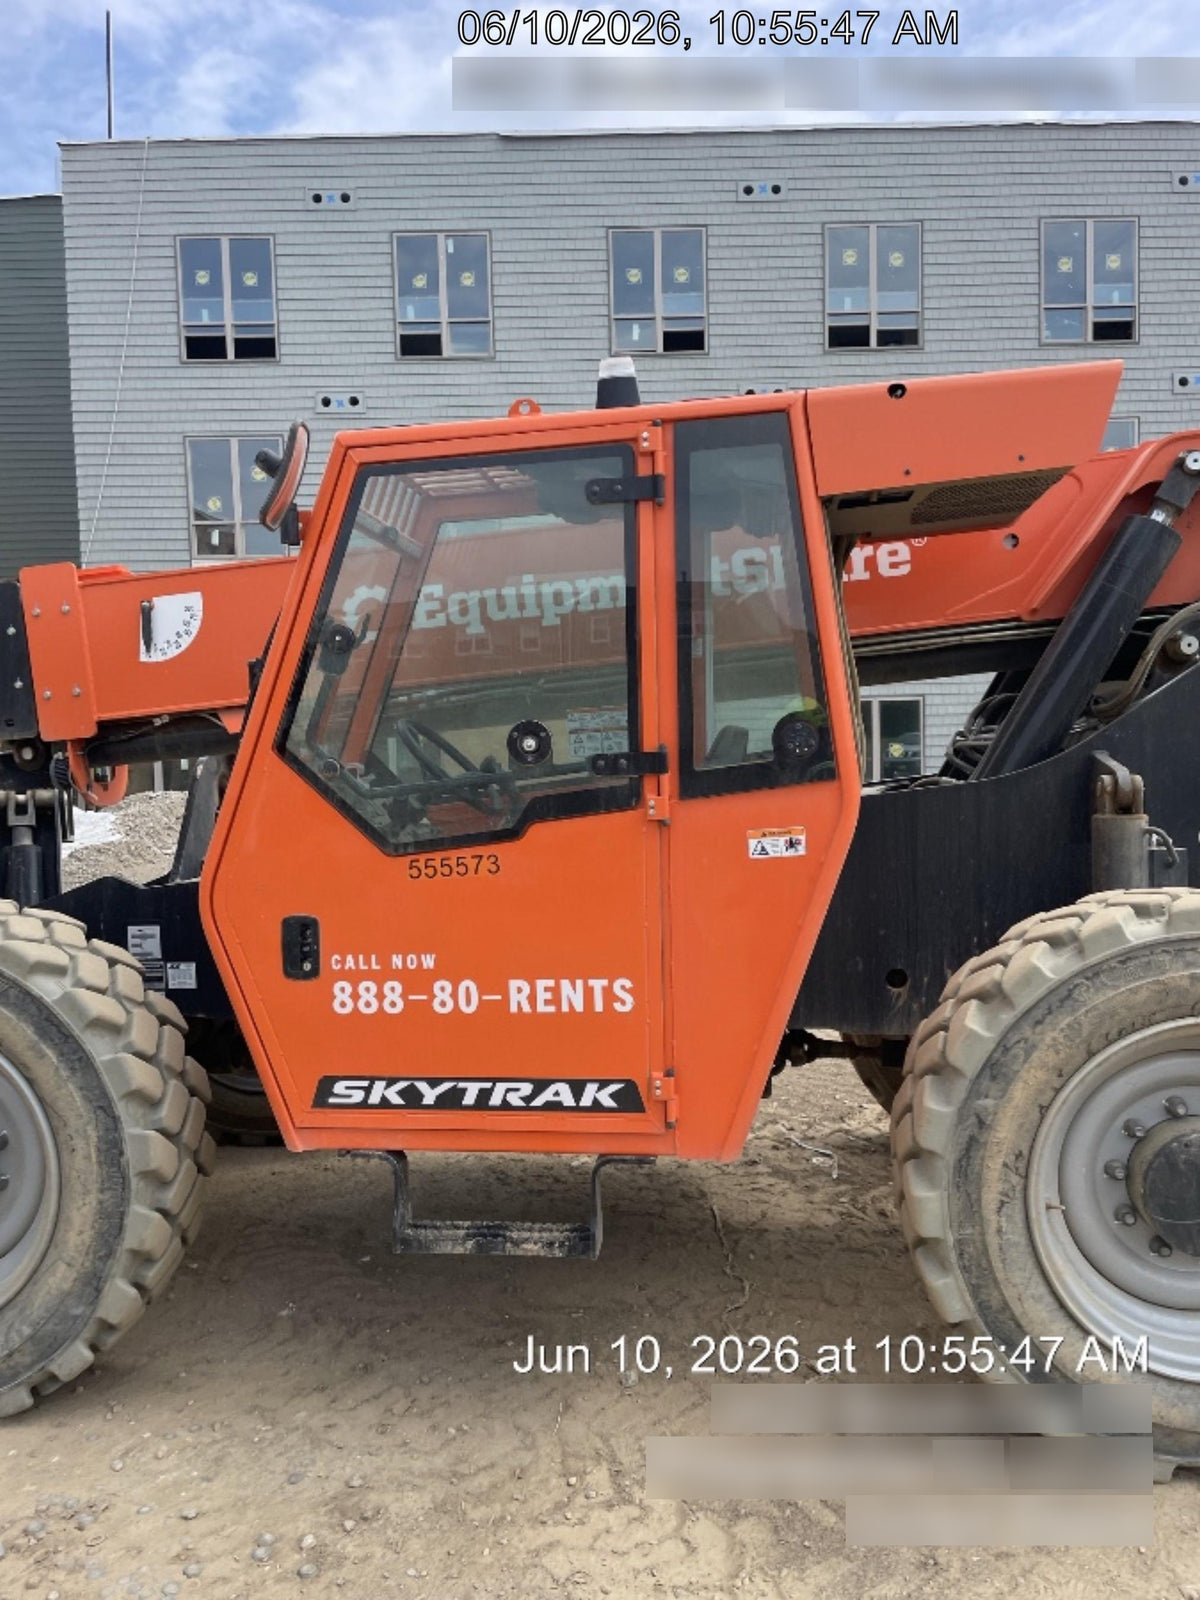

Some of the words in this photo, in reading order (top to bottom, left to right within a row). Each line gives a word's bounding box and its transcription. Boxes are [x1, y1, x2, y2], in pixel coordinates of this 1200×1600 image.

[408, 854, 500, 880] 555573
[331, 954, 381, 970] CALL
[392, 953, 436, 970] NOW
[332, 978, 634, 1015] 888-80-RENTS
[328, 1080, 625, 1108] SKYTRAK
